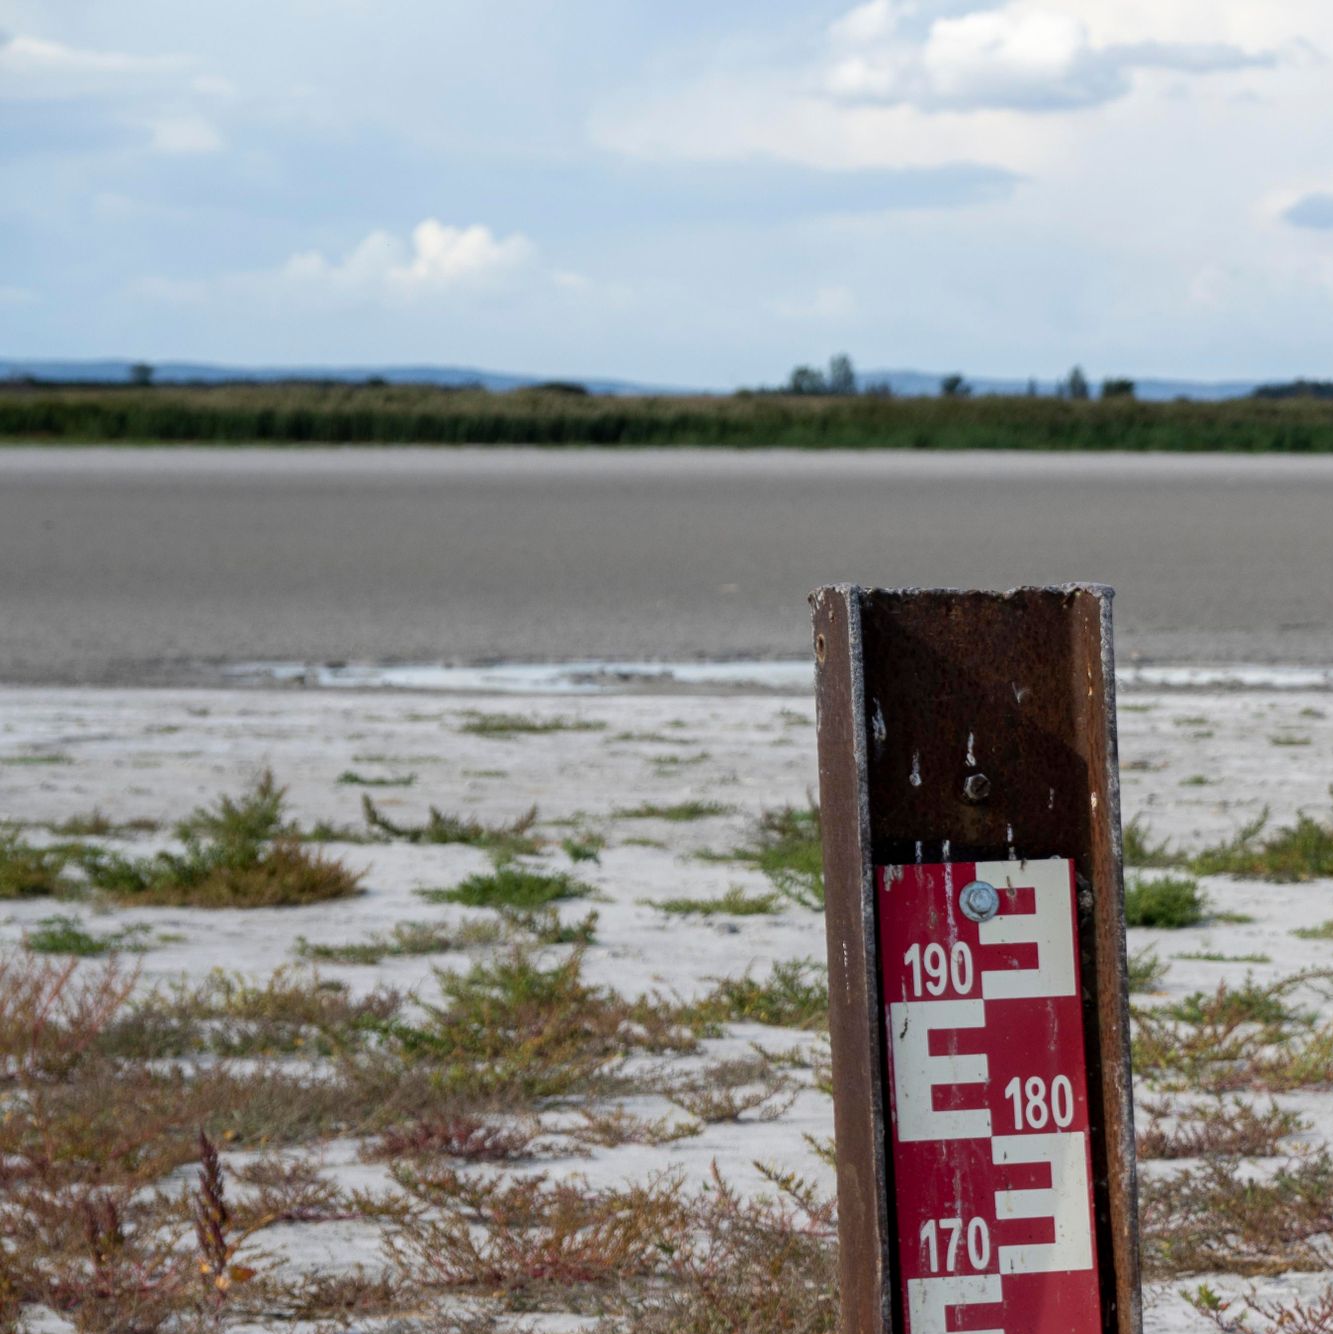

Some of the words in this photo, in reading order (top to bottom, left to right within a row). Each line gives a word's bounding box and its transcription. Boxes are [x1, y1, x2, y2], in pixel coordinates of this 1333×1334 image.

[904, 940, 973, 996] 190
[1004, 1074, 1074, 1130] 180
[920, 1216, 990, 1272] 170
